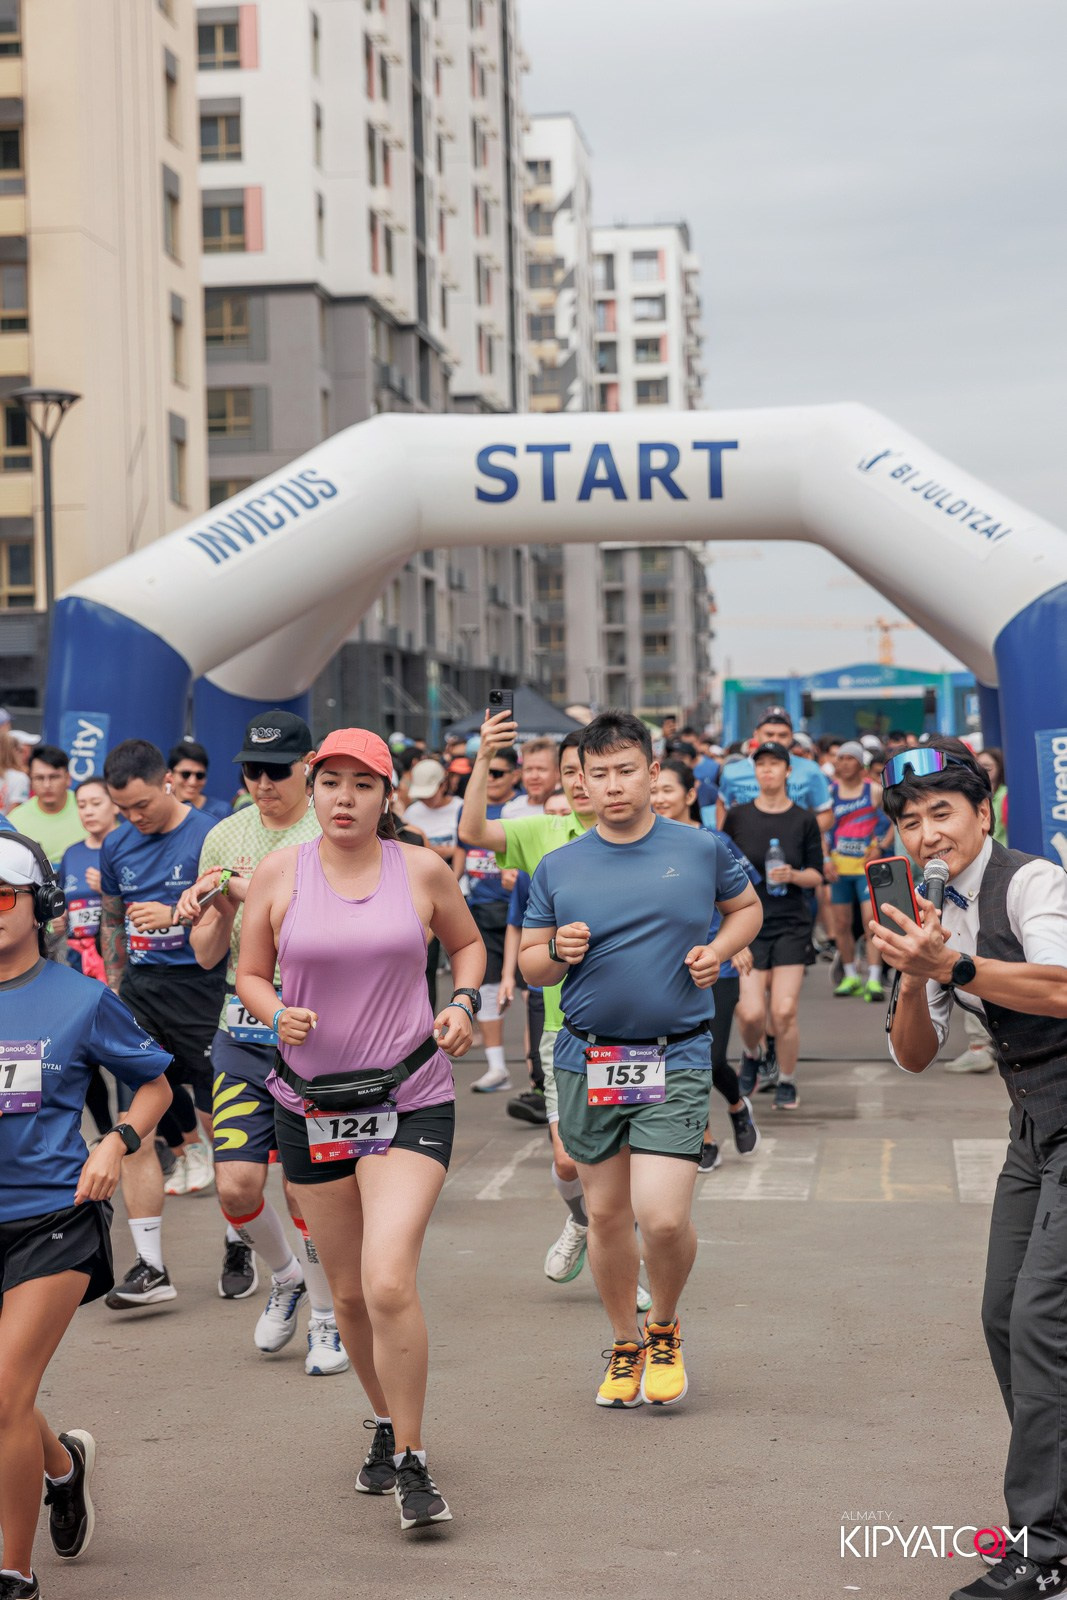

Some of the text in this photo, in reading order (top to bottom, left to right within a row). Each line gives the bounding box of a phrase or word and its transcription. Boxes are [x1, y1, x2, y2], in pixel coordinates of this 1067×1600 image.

[475, 440, 739, 504] START
[890, 463, 920, 485] BI
[188, 469, 338, 565] INVICTUS
[68, 718, 104, 782] City
[1051, 736, 1067, 822] Arena
[237, 1006, 266, 1026] 18
[590, 1050, 599, 1058] 10
[0, 1063, 17, 1088] 1
[42, 1063, 61, 1071] DYZAI
[606, 1064, 648, 1086] 153
[329, 1116, 379, 1139] 124
[51, 1232, 64, 1240] RUN
